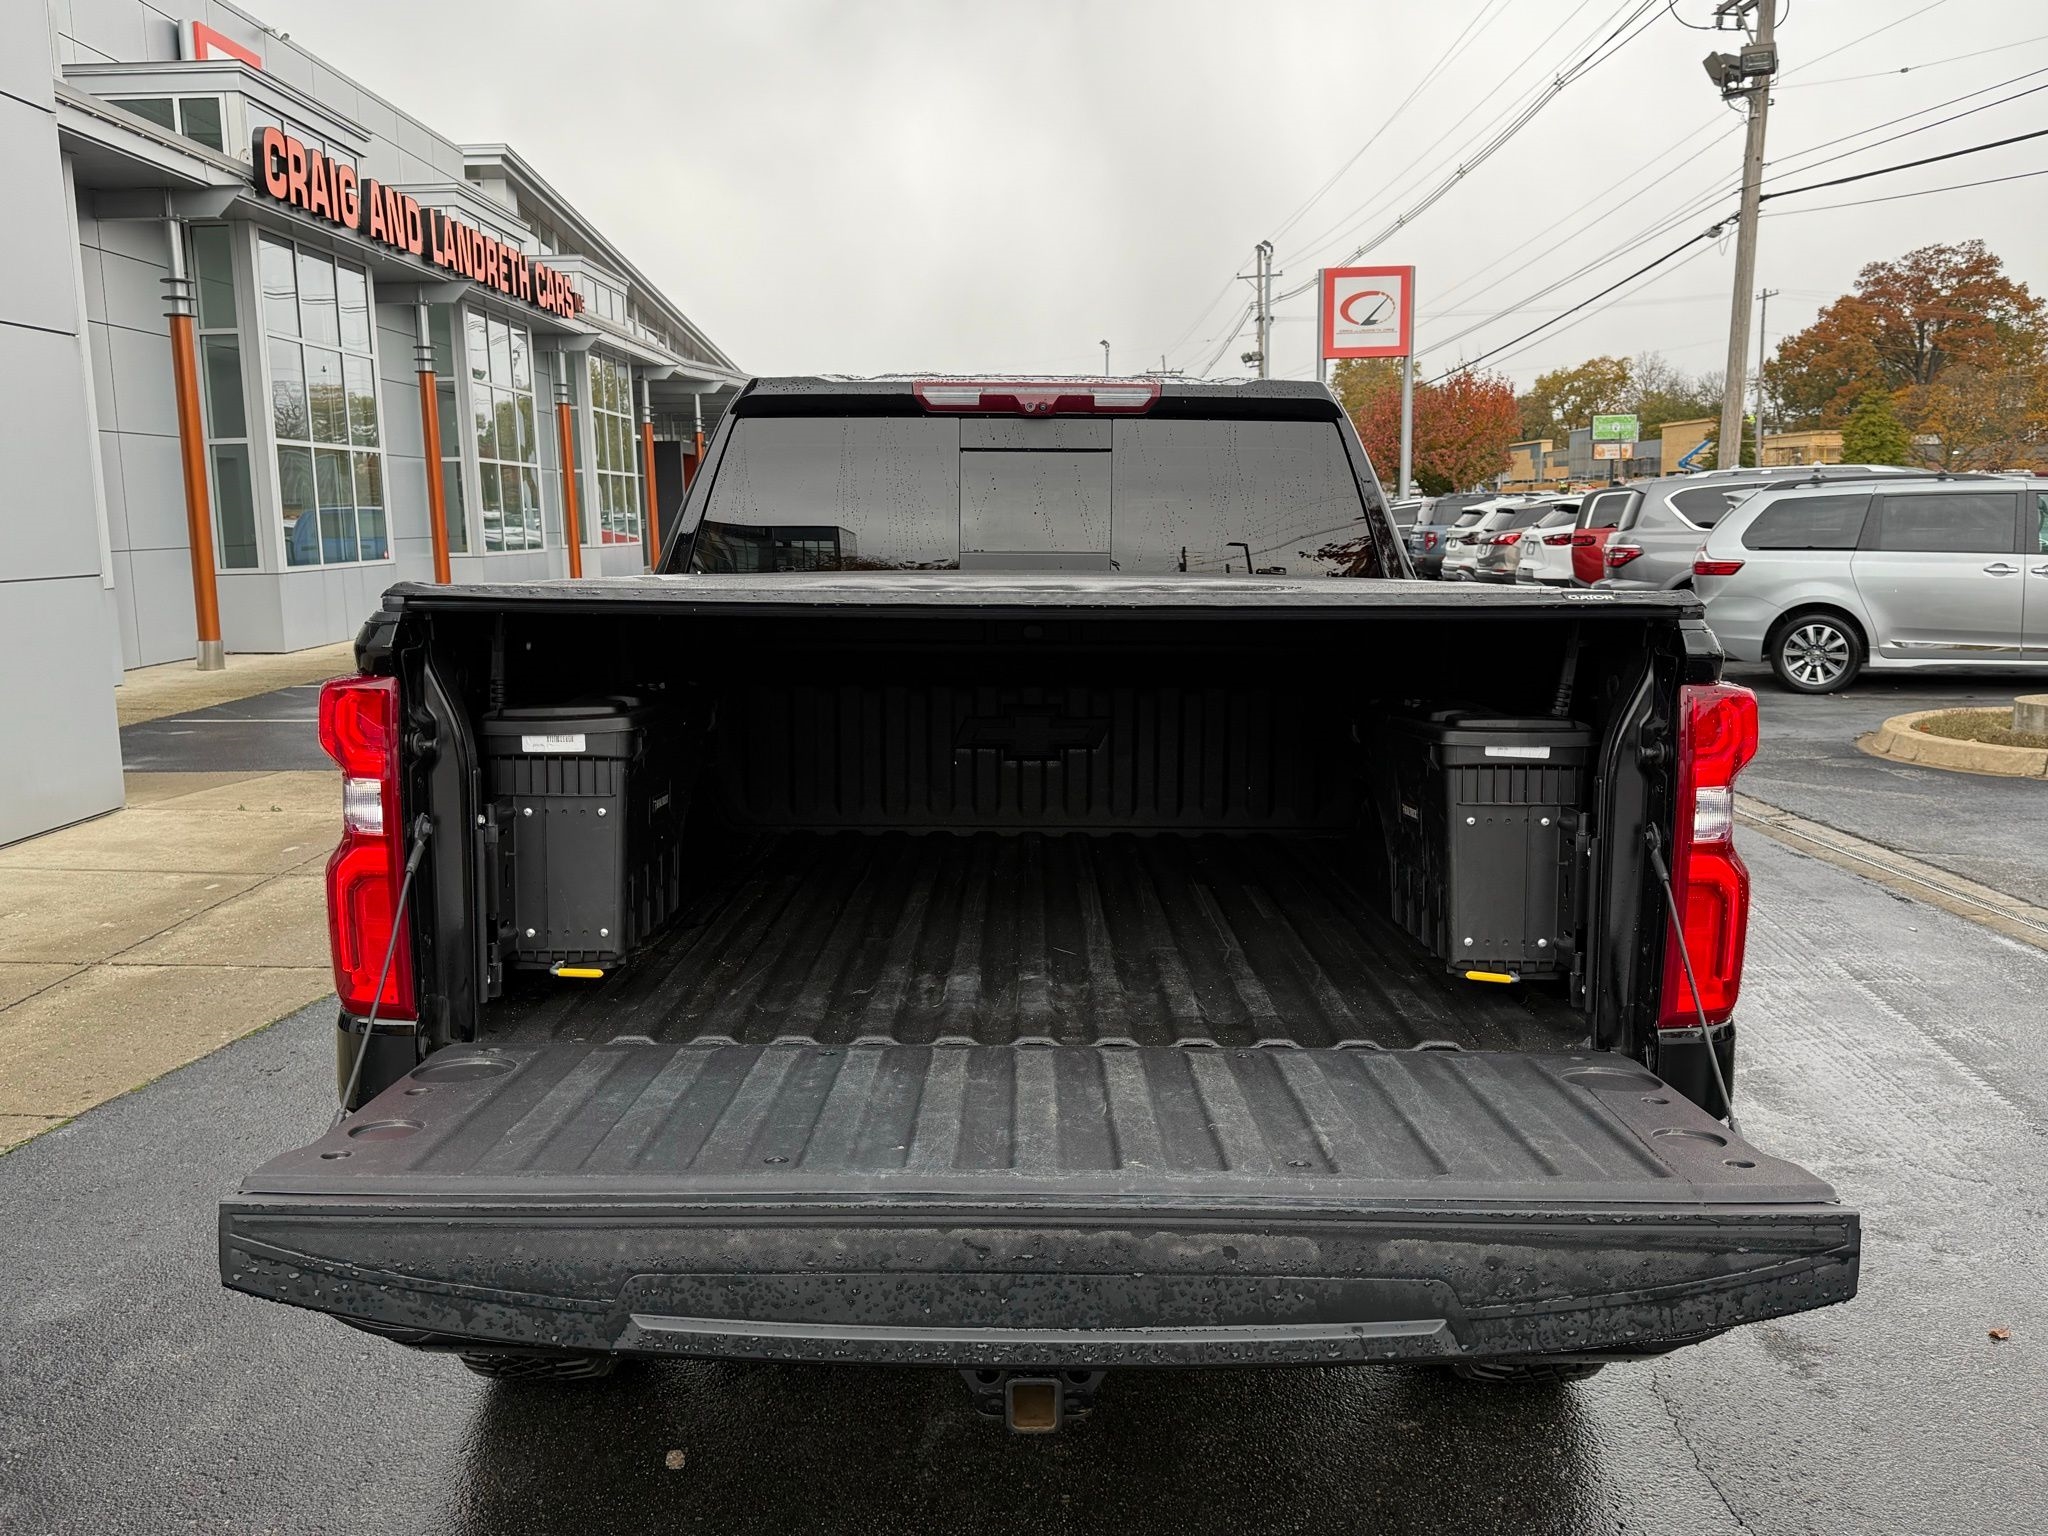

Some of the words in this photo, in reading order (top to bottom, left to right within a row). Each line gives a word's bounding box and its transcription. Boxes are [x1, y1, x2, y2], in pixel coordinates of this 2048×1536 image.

[258, 126, 359, 230] CRAIG
[367, 178, 424, 256] AND
[427, 208, 532, 301] LANDRETH
[533, 261, 575, 320] CARS
